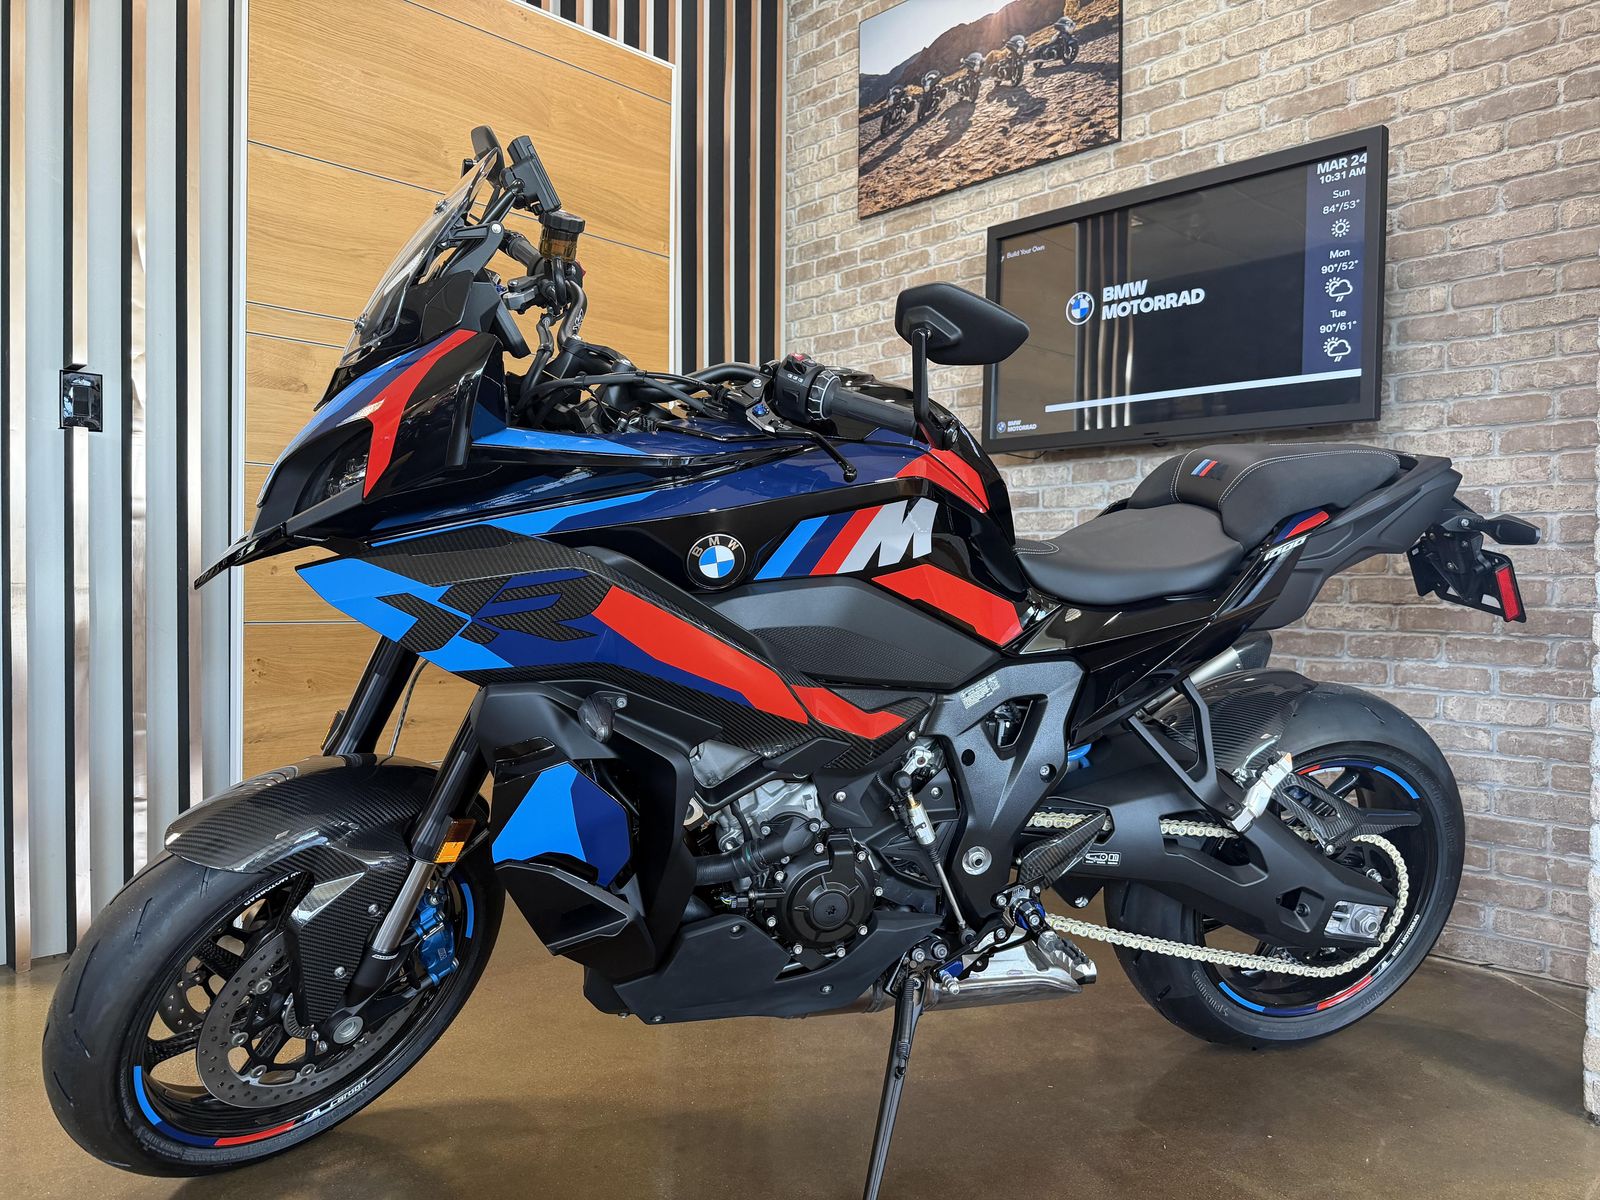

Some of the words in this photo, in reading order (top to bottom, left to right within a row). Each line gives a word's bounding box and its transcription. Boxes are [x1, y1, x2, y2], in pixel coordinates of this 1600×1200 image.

[1317, 157, 1348, 175] MAR
[1350, 152, 1368, 167] 24
[1320, 171, 1346, 184] 10:31
[1349, 166, 1366, 178] AM
[1333, 189, 1351, 199] Sun
[1329, 249, 1350, 259] Mon
[1103, 279, 1148, 302] BMW
[1102, 288, 1206, 320] MOTORRAD
[1330, 309, 1347, 318] Tue
[835, 497, 939, 574] M
[691, 536, 740, 558] BMW
